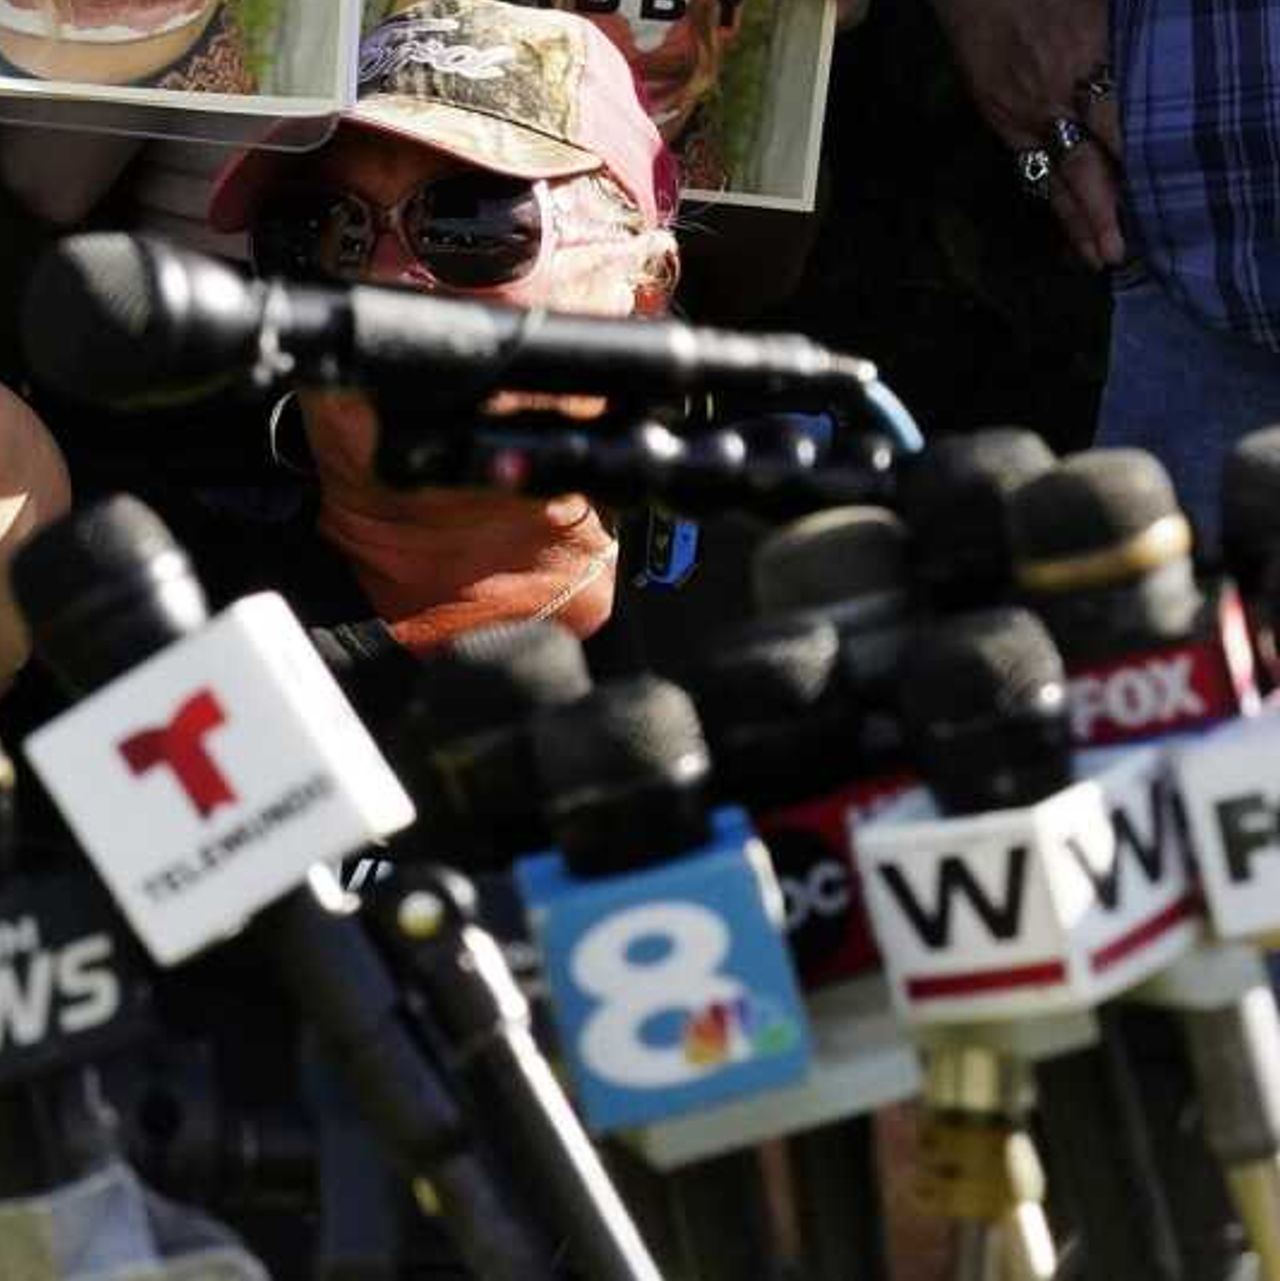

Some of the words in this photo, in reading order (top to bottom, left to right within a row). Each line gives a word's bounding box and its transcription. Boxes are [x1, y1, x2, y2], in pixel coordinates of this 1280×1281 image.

[1070, 652, 1207, 740] FOX
[1214, 790, 1280, 883] F
[878, 844, 1028, 956] W
[570, 900, 746, 1088] 8
